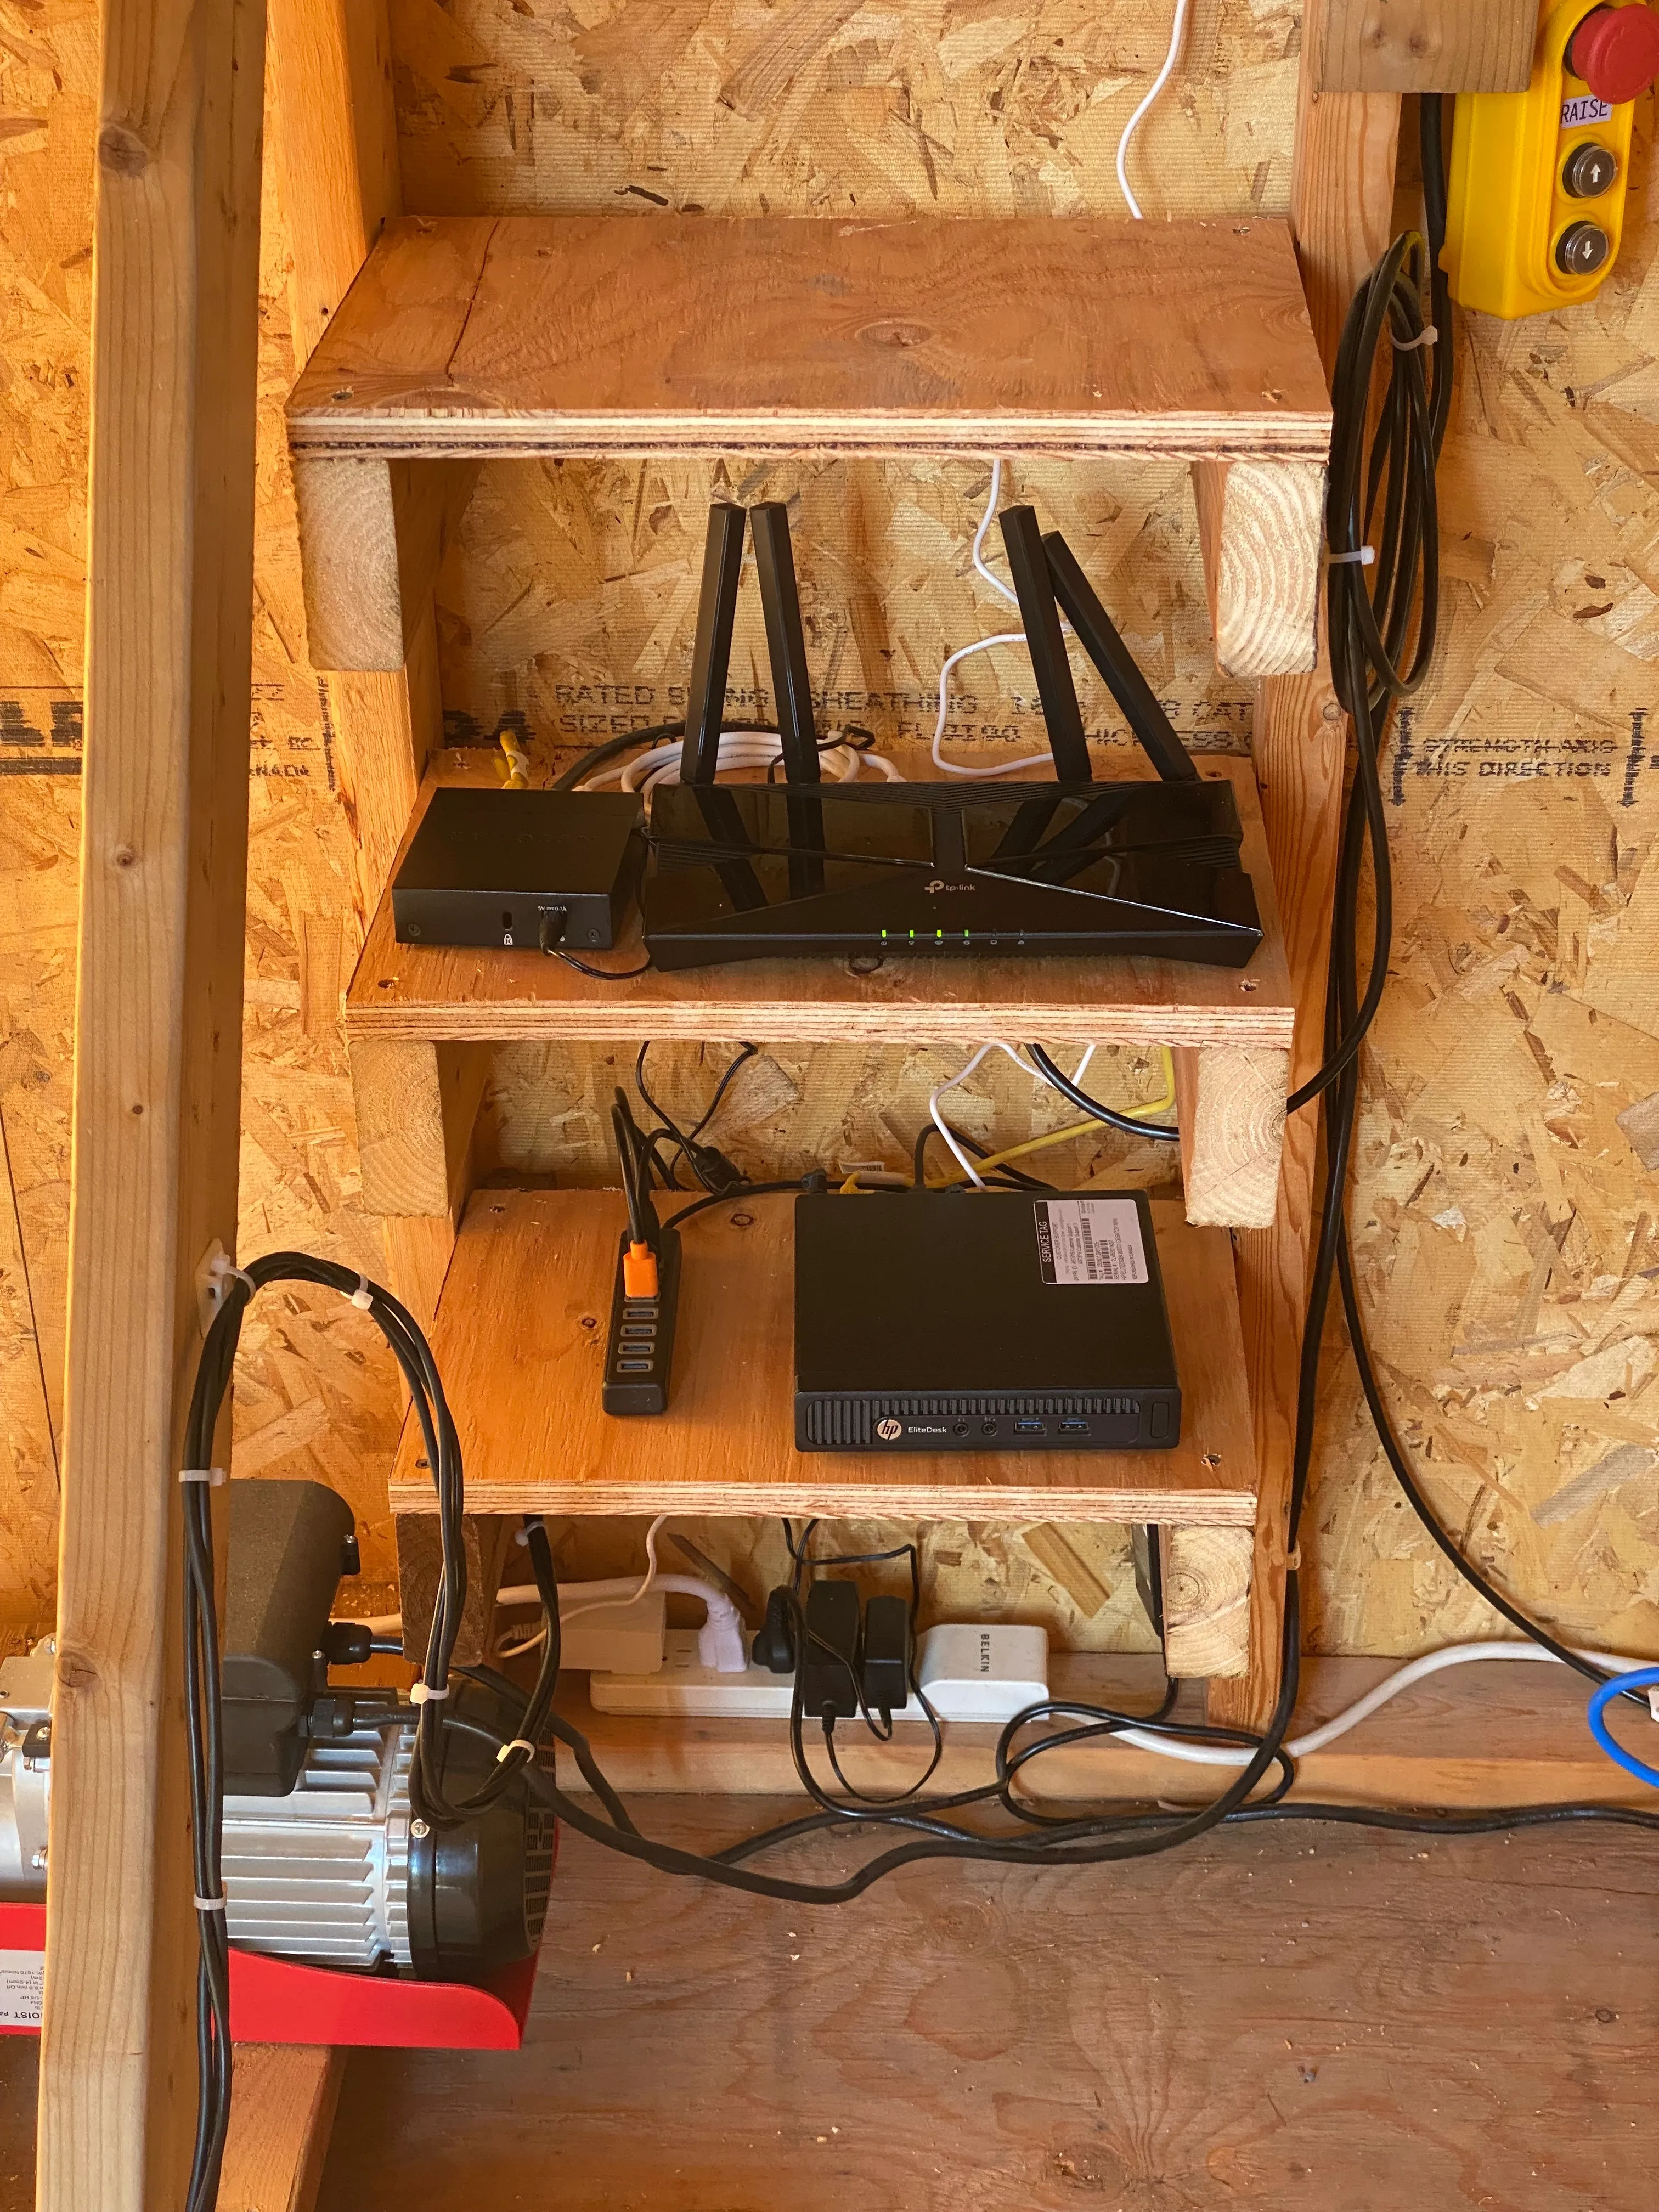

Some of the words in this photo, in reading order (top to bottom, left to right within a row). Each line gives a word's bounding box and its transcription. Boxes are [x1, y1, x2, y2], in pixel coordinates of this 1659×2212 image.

[1561, 99, 1607, 124] RAISE
[555, 684, 656, 705] RATED
[1423, 738, 1560, 754] STRENGTH
[1413, 761, 1470, 777] THIS
[1479, 761, 1611, 777] DIRECTION
[945, 884, 975, 892] tp-link
[1039, 1221, 1048, 1233] TAG
[1040, 1234, 1051, 1262] SERVICE
[880, 1419, 899, 1440] hp
[980, 1634, 990, 1672] BELKIN
